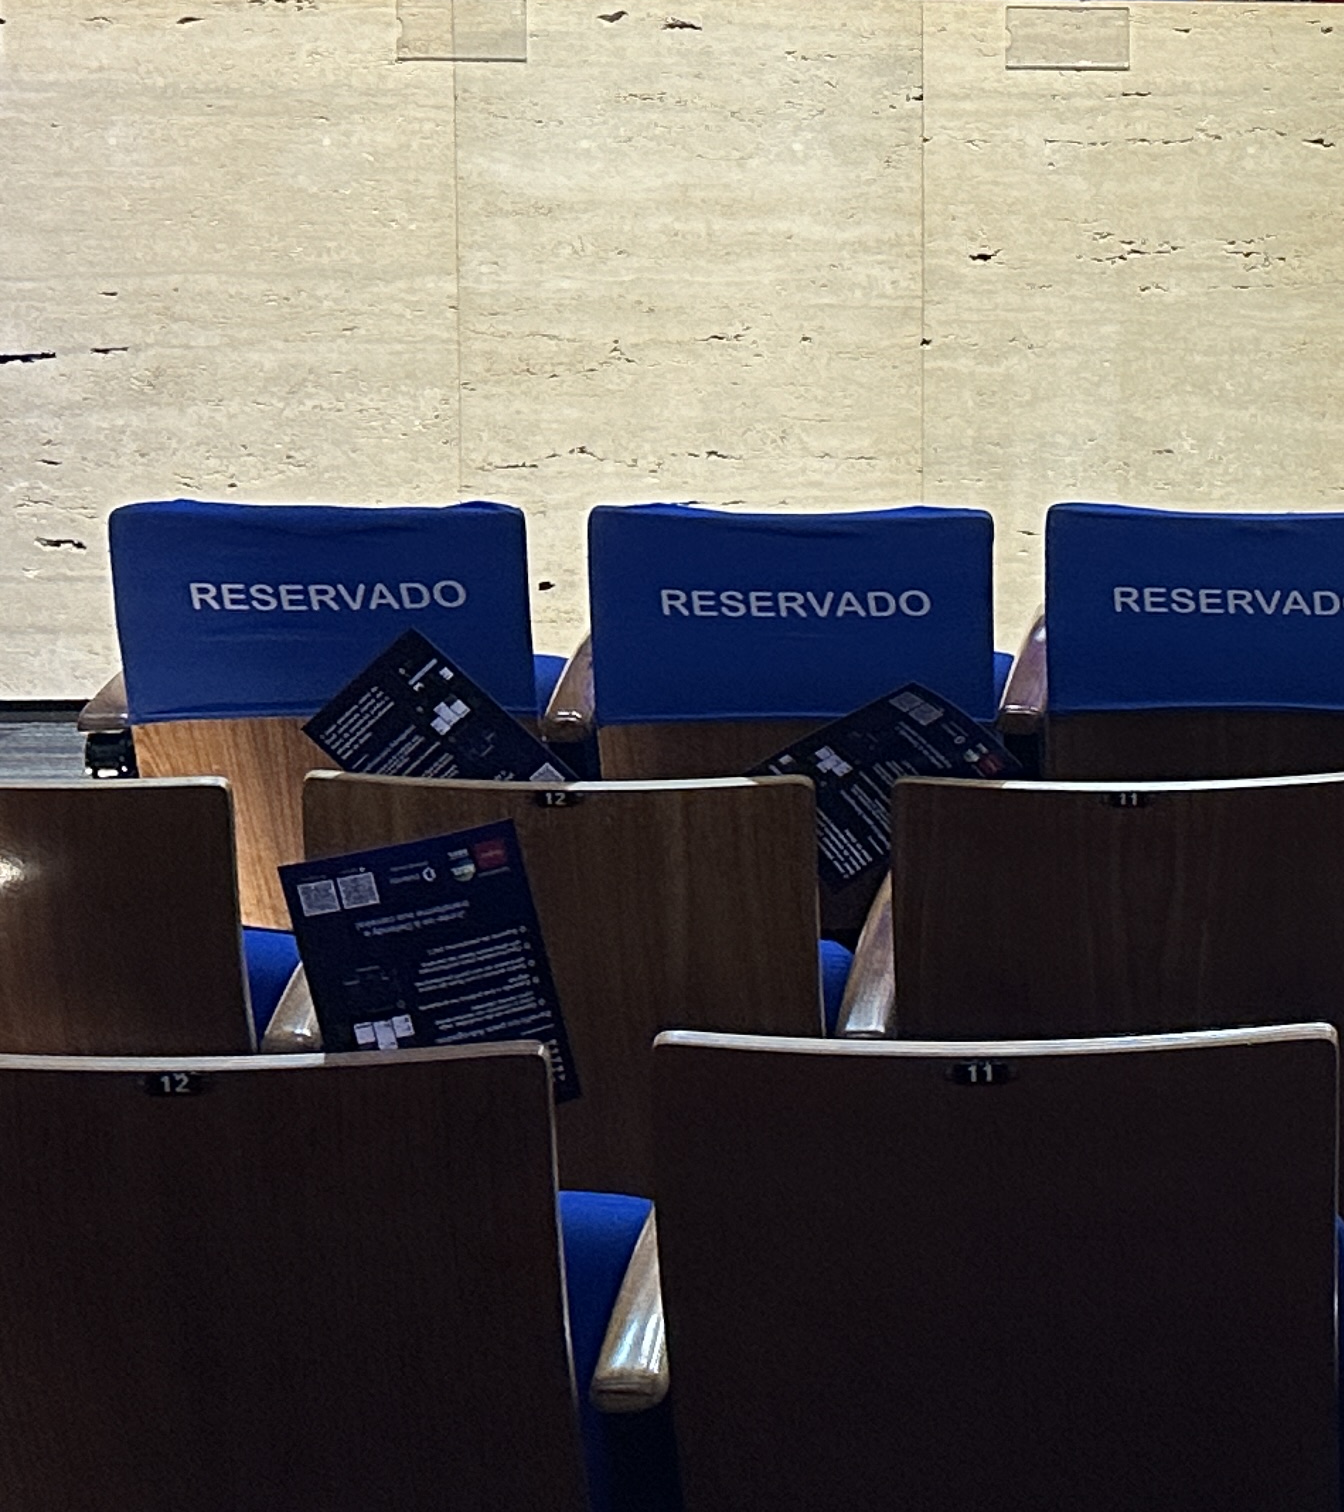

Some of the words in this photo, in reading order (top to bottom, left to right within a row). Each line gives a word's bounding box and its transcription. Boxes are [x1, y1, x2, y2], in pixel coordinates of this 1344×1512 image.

[190, 581, 465, 610] RESERVADO
[661, 590, 930, 617] RESERVADO
[545, 792, 566, 806] 12
[1120, 792, 1138, 805] 11
[967, 1062, 993, 1083] 11
[160, 1073, 190, 1093] 12
